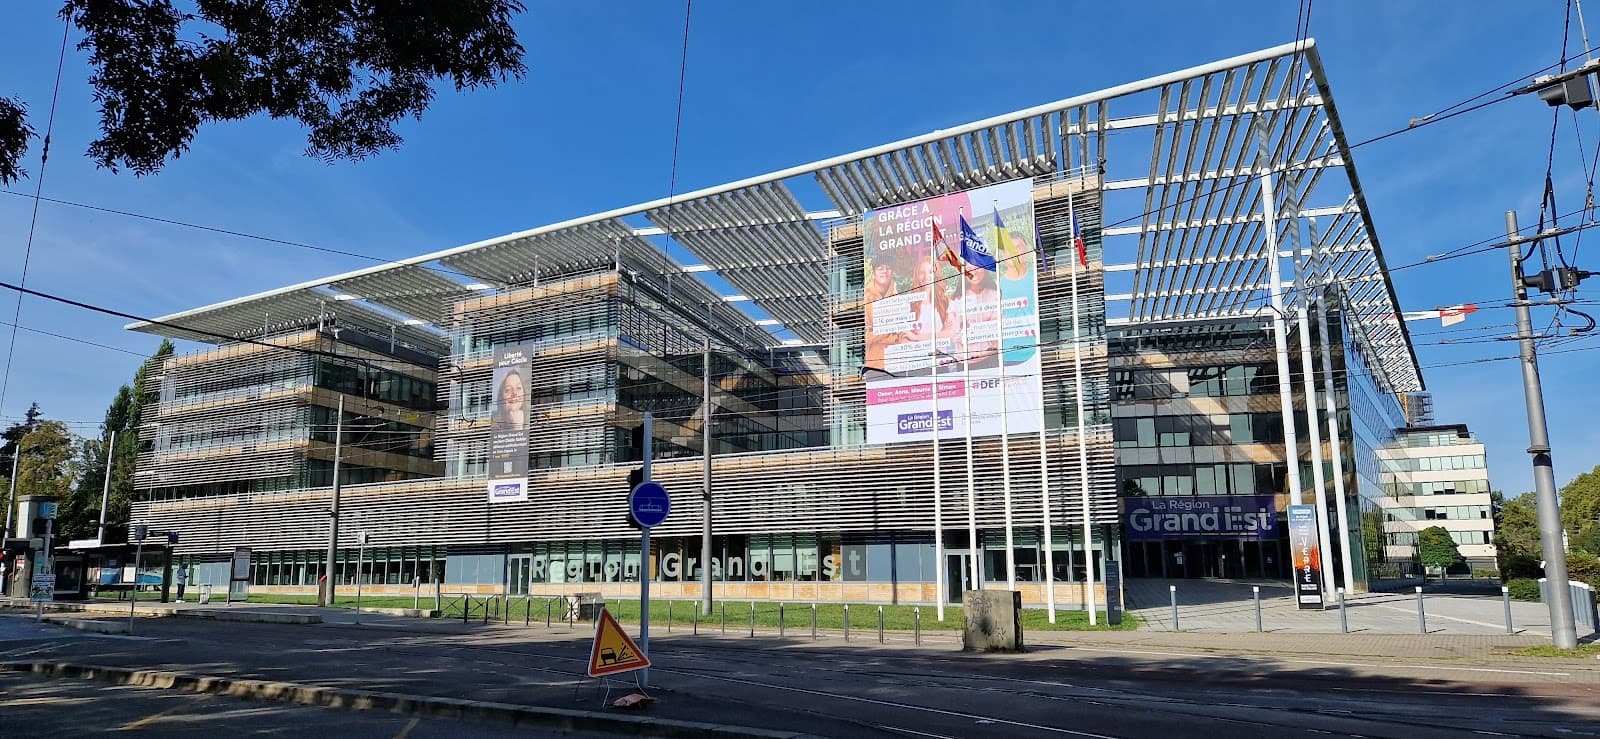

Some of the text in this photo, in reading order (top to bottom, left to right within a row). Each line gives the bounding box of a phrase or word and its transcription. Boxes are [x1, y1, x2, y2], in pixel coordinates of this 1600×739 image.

[878, 205, 918, 223] GRÂCE
[879, 215, 943, 237] LA RÉGION
[879, 234, 921, 251] GRAND
[925, 228, 957, 243] ET...
[899, 417, 933, 430] Grand
[1152, 500, 1210, 511] La Région
[1129, 507, 1219, 532] Grand
[1224, 507, 1272, 531] Est
[662, 551, 770, 578] Grand
